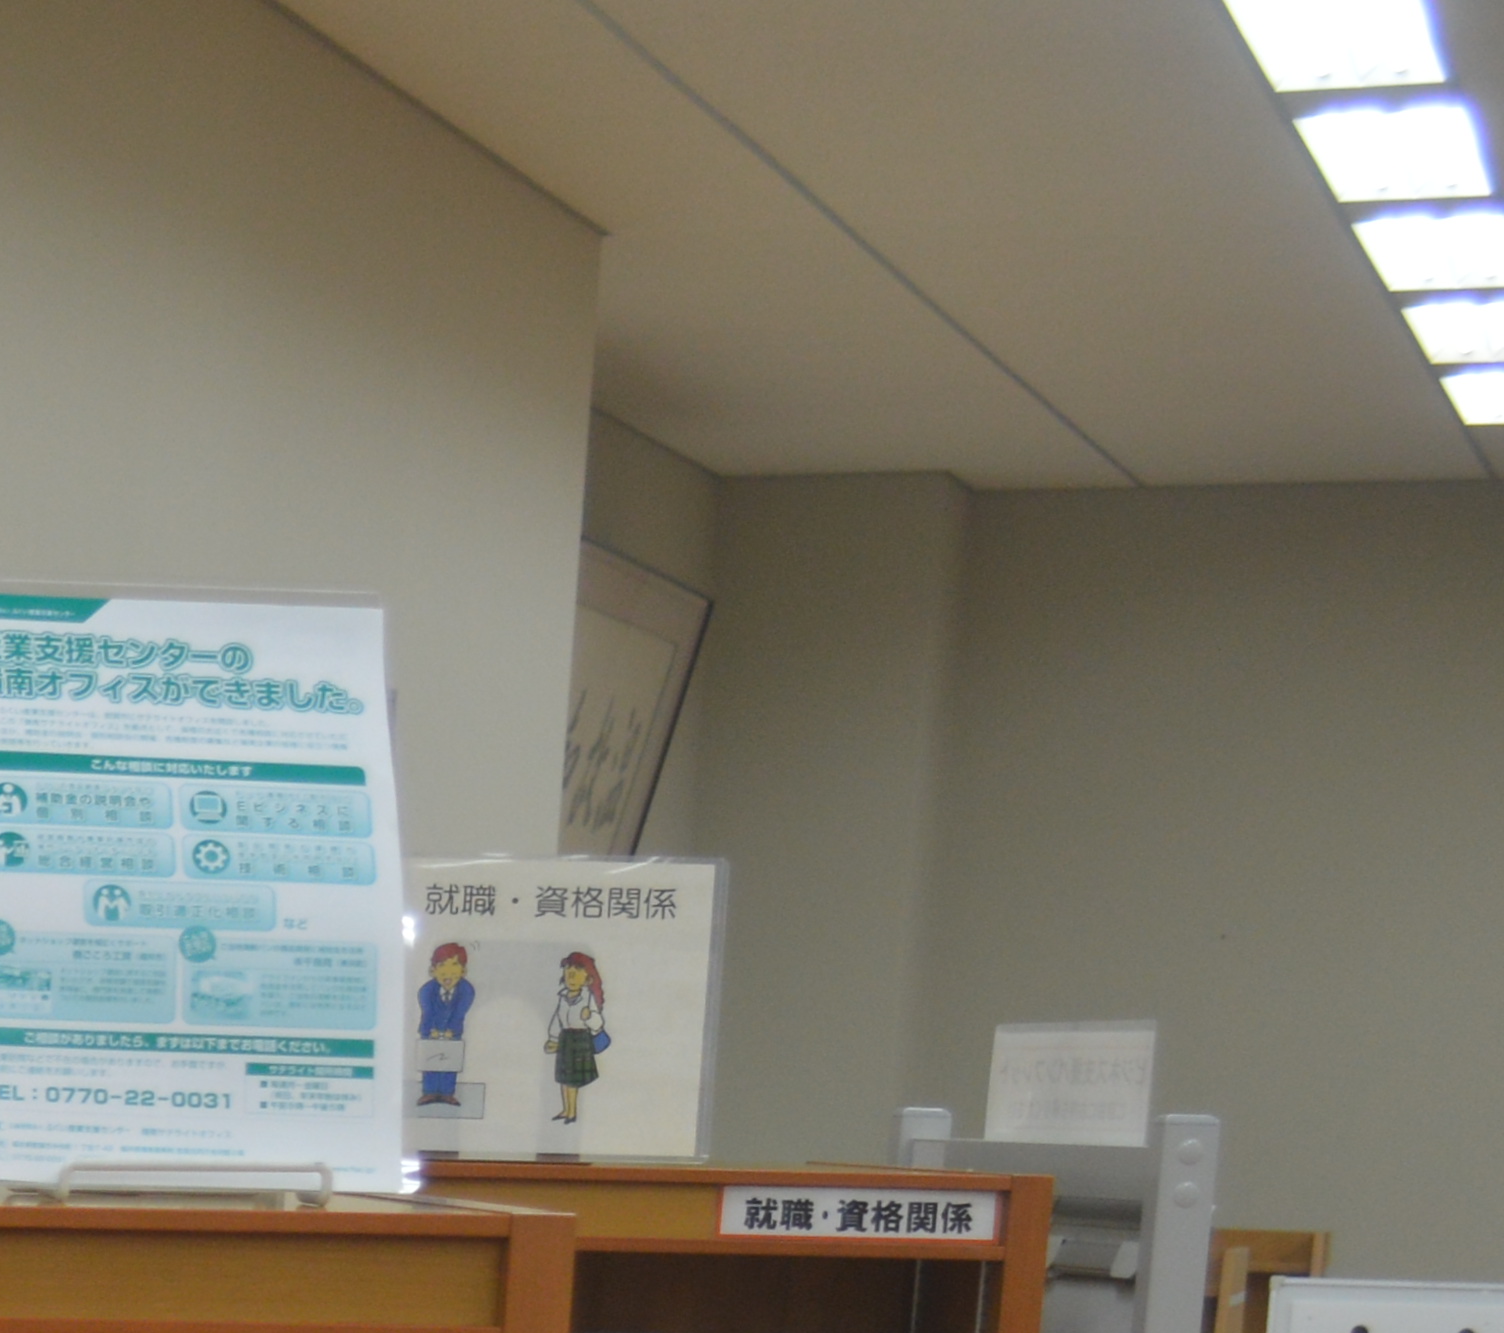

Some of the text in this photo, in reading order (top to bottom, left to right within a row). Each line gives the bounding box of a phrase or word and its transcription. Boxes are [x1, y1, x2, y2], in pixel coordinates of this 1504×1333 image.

[91, 758, 253, 777] こんな相談に対応いたします
[35, 791, 152, 807] 補助金の説明会や
[422, 880, 679, 922] 就職・資格関係
[743, 1198, 974, 1234] 就職・資格関係
